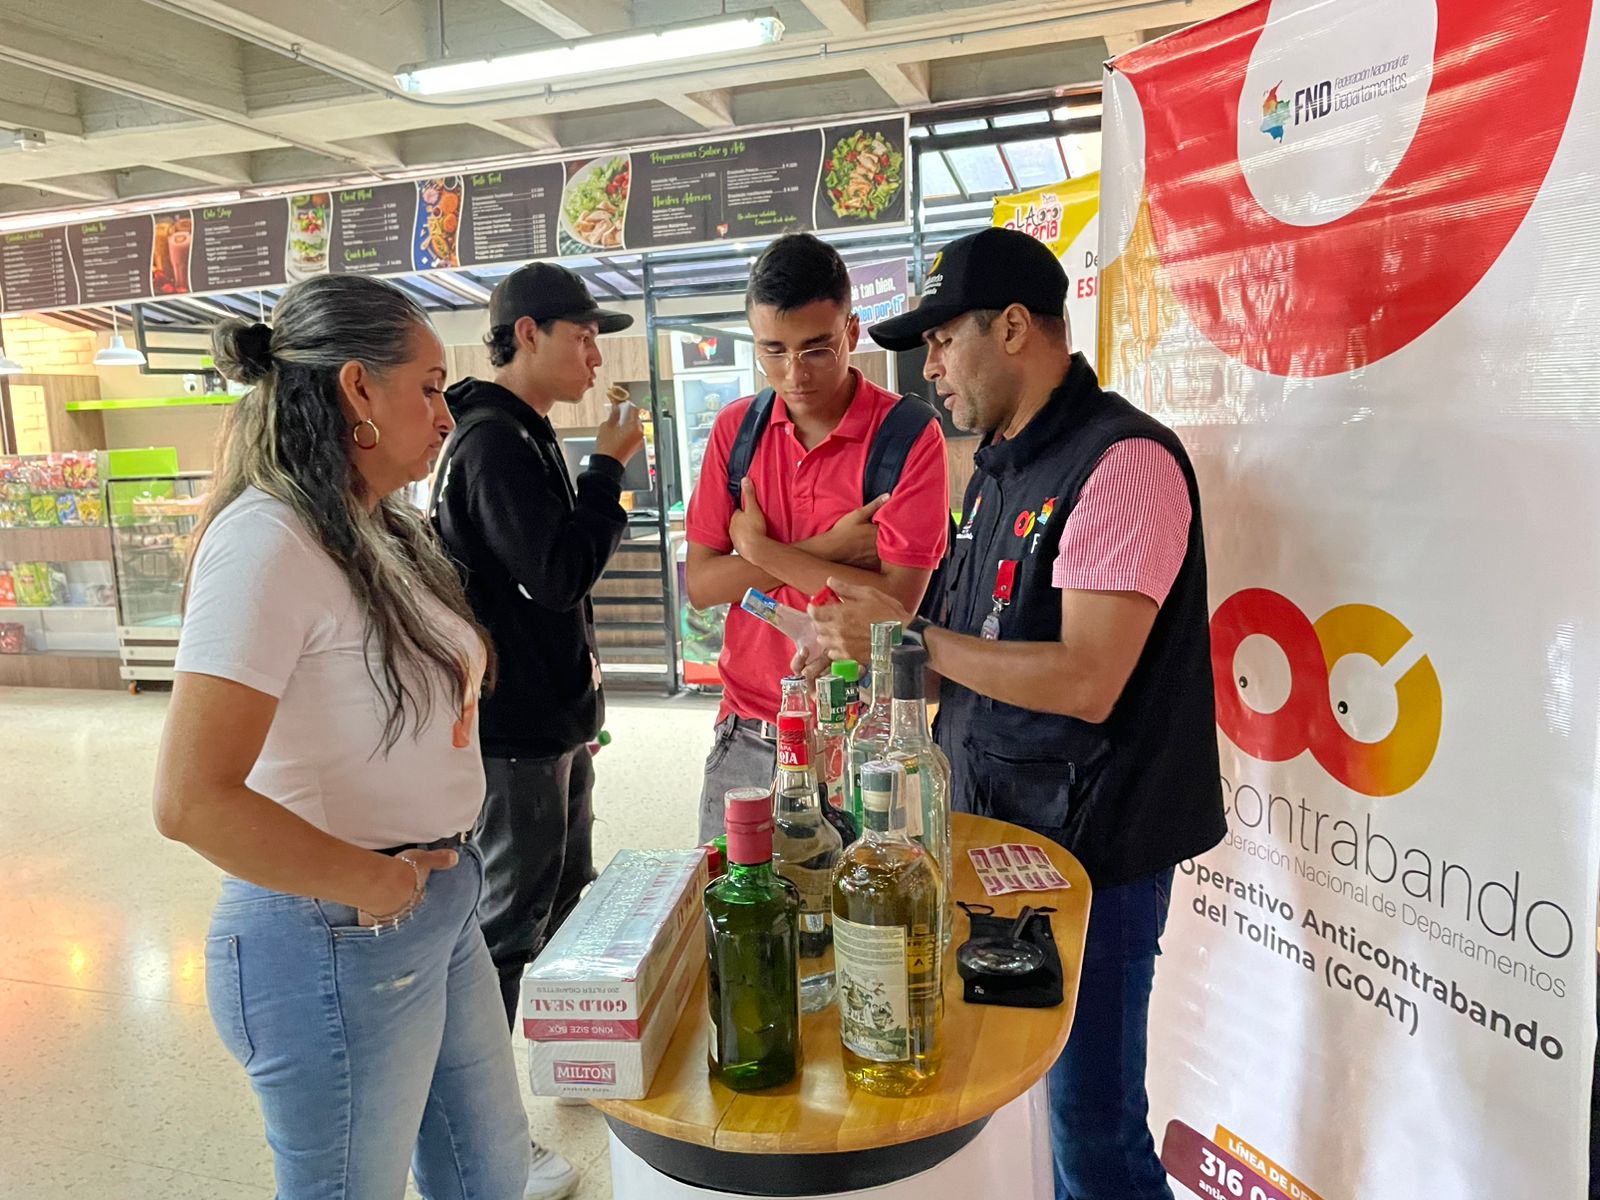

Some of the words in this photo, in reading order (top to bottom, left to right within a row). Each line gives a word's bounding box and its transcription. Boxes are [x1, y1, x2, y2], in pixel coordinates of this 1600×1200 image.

[1334, 68, 1371, 90] Federación
[1371, 57, 1400, 78] Nacional
[1400, 54, 1409, 70] de
[1294, 80, 1332, 126] FND
[1334, 72, 1407, 112] Departamentos
[779, 751, 798, 764] OJA
[1223, 829, 1290, 871] deración
[1294, 856, 1369, 906] Nacional
[1372, 888, 1397, 918] de
[1402, 903, 1567, 999] Departamentos
[1192, 894, 1227, 927] del
[1234, 911, 1316, 972] Tolima
[1325, 956, 1419, 1036] (GOAT)
[1302, 908, 1564, 1061] Anticontrabando
[530, 999, 575, 1012] SEAL
[579, 999, 628, 1012] GOLD
[548, 1025, 568, 1034] BOX
[570, 1026, 590, 1034] SIZE
[591, 1026, 614, 1034] KING
[557, 1066, 612, 1079] MILTON
[1199, 1147, 1244, 1197] 316
[1228, 1138, 1267, 1175] LÍNEA
[1269, 1168, 1288, 1190] DE
